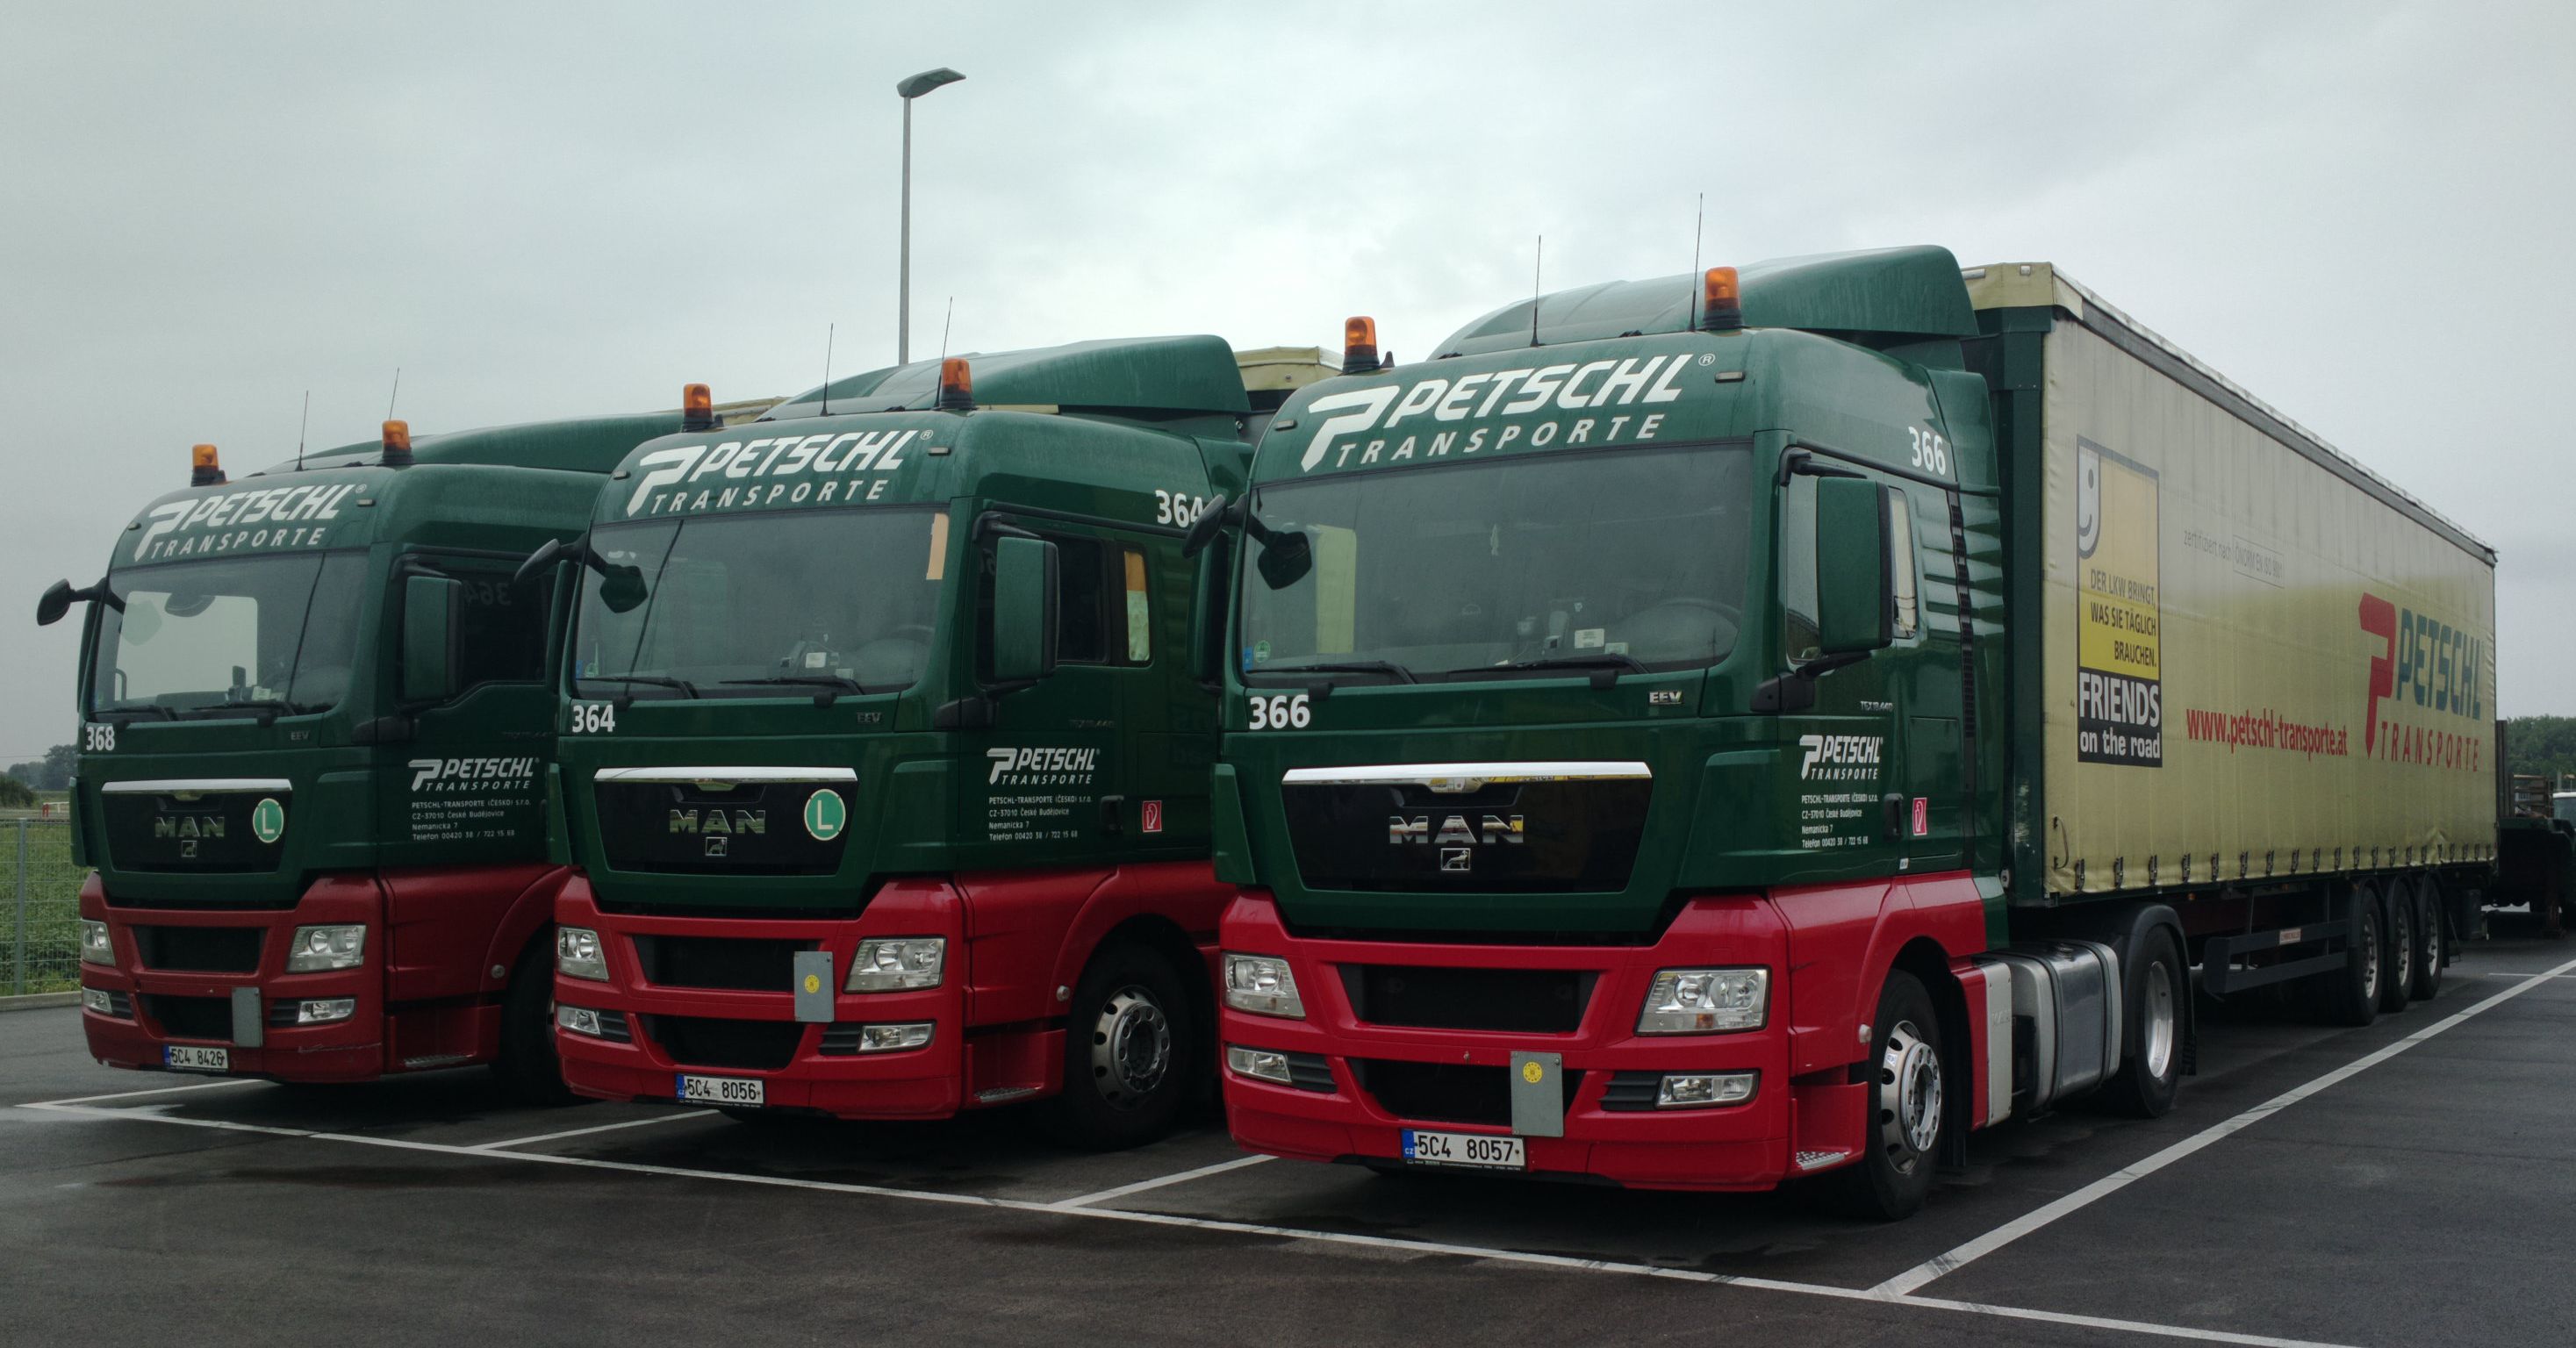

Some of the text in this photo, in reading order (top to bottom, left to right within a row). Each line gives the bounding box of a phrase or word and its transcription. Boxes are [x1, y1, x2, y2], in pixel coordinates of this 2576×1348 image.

[1383, 354, 1693, 428] PETSCHL
[687, 430, 917, 482] PETSCHL
[1336, 414, 1664, 468] TRANSPORTE
[1908, 426, 1946, 475] 366
[179, 484, 355, 531] PETSCHL
[651, 479, 888, 514] TRANSPORTE
[1155, 489, 1203, 528] 364
[151, 527, 326, 559] TRANSPORTE
[2091, 568, 2106, 592] DER
[2109, 573, 2126, 598] LKW
[2091, 601, 2156, 636] WAS SIE TÄGLICH
[2114, 641, 2156, 668] BRAUCHEN.
[2396, 607, 2481, 721] PETSCHL
[1249, 693, 1310, 730] 366
[1649, 691, 1683, 705] EEV
[2078, 670, 2159, 728] FRIENDS
[572, 704, 615, 733] 364
[86, 726, 116, 751] 368
[1821, 735, 1880, 764] PETSCHL
[2079, 727, 2160, 759] on the road
[2186, 707, 2348, 762] www.petschl-transporte.at
[2381, 721, 2479, 772] TRANSPORTE
[441, 757, 534, 778] PETSCHL
[1015, 748, 1095, 771] PETSCHL
[1811, 768, 1879, 780] TRANSPORTE
[426, 780, 530, 792] TRANSPORTE
[1001, 774, 1092, 785] TRANSPORTE
[155, 816, 226, 838] MAN
[262, 807, 276, 835] L
[669, 809, 767, 835] MAN
[817, 799, 834, 830] L
[1389, 814, 1524, 844] MAN
[171, 1048, 190, 1064] 5C4
[197, 1050, 225, 1065] 8426
[686, 1079, 710, 1096] 5C4
[721, 1081, 757, 1100] 8056
[1417, 1135, 1451, 1158] 5C4
[1467, 1139, 1514, 1162] 8057
